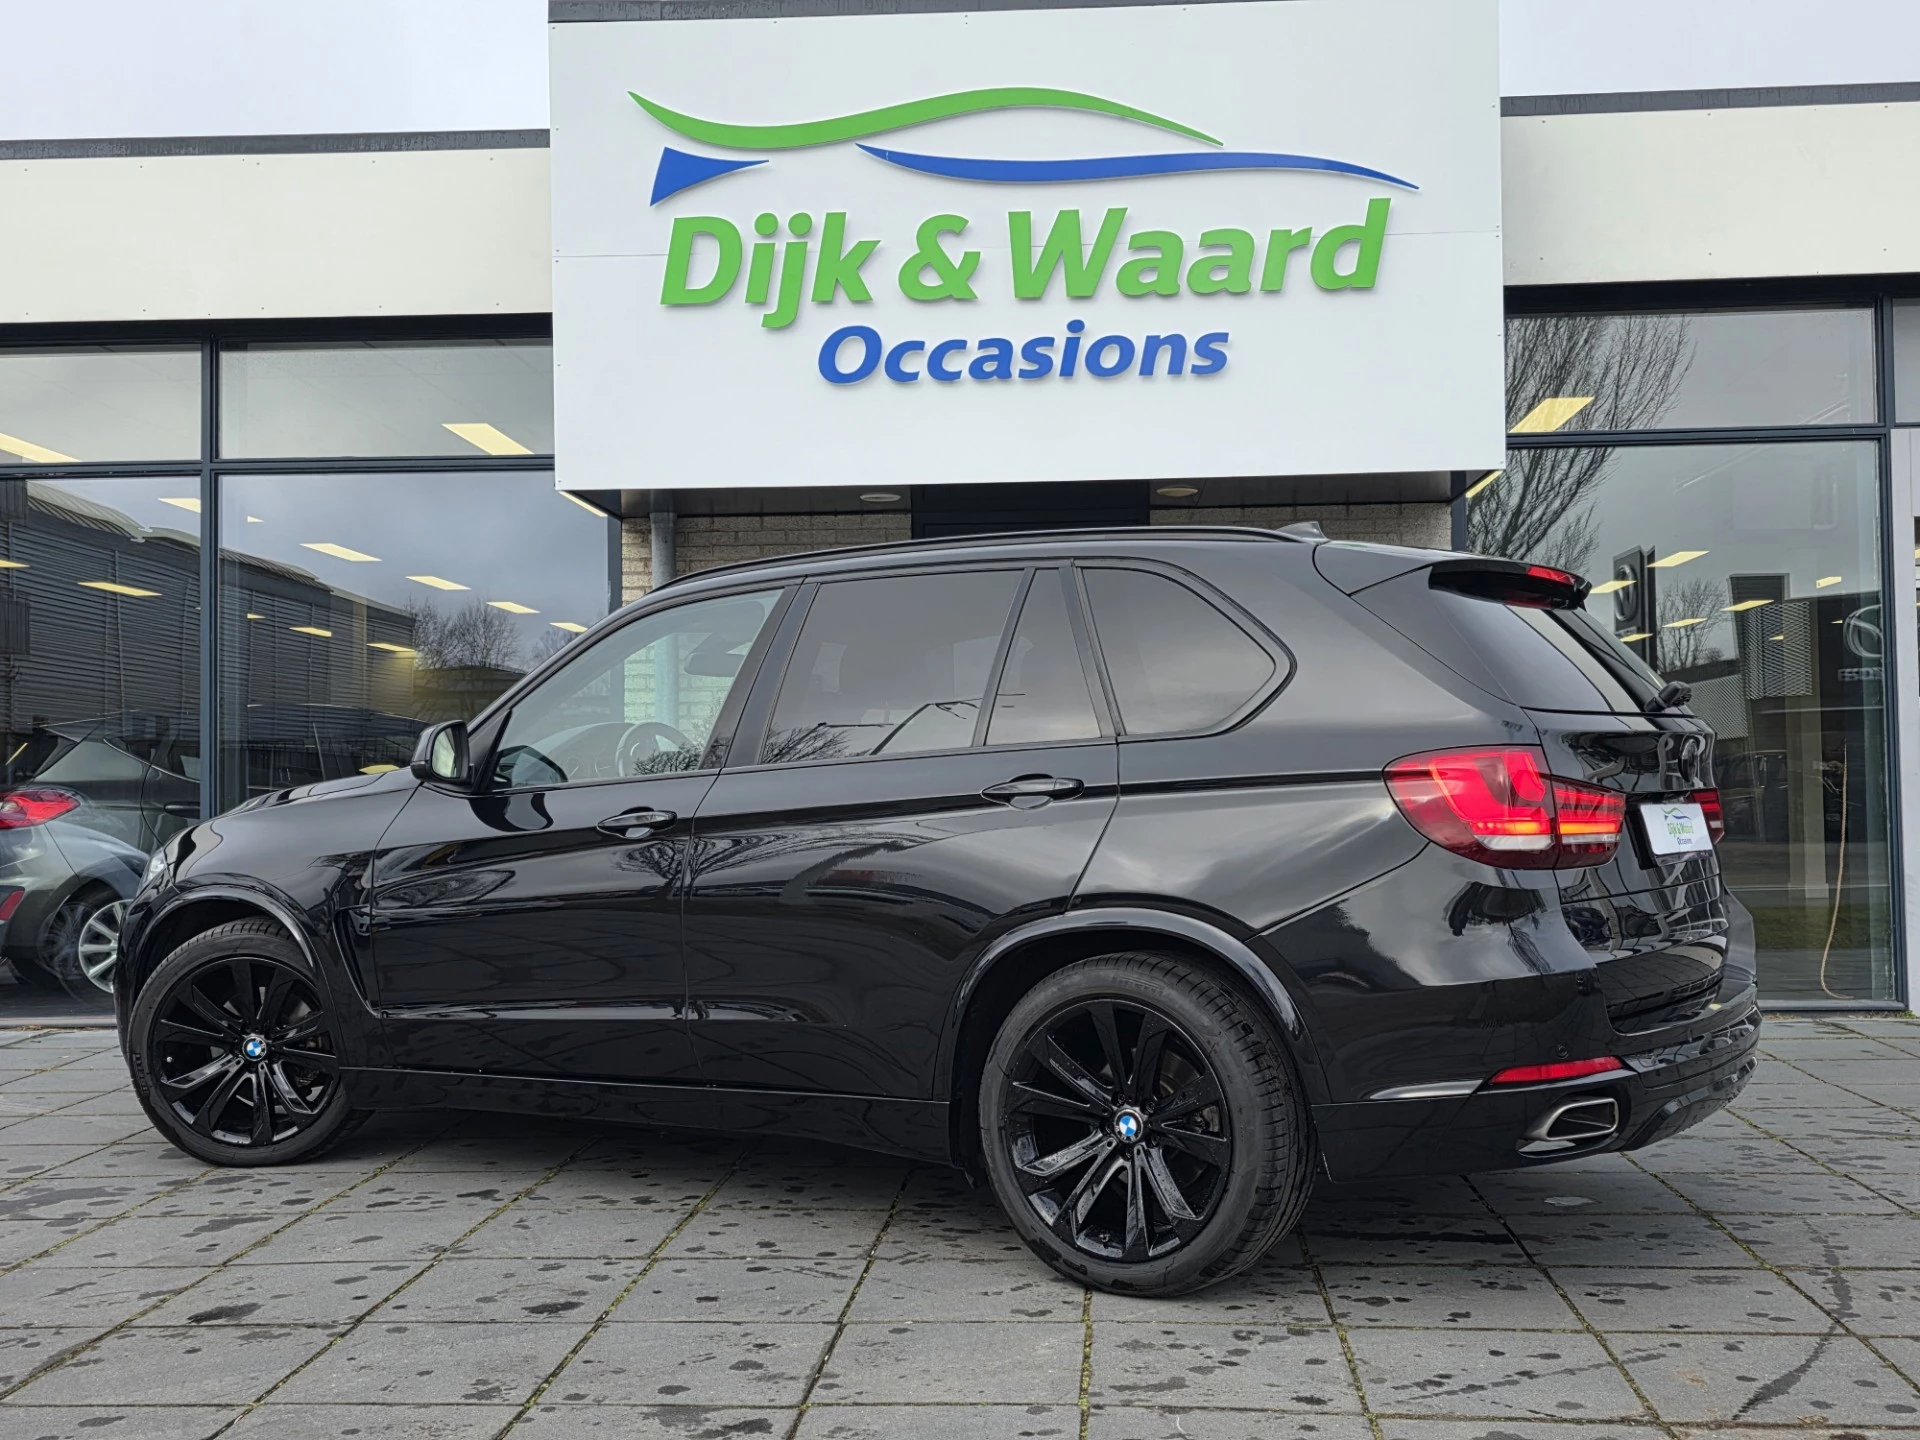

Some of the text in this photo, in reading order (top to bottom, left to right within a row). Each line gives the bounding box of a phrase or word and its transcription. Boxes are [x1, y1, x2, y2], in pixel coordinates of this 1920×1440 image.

[661, 198, 1391, 328] Dijk & Waard
[818, 319, 1229, 384] Occasions
